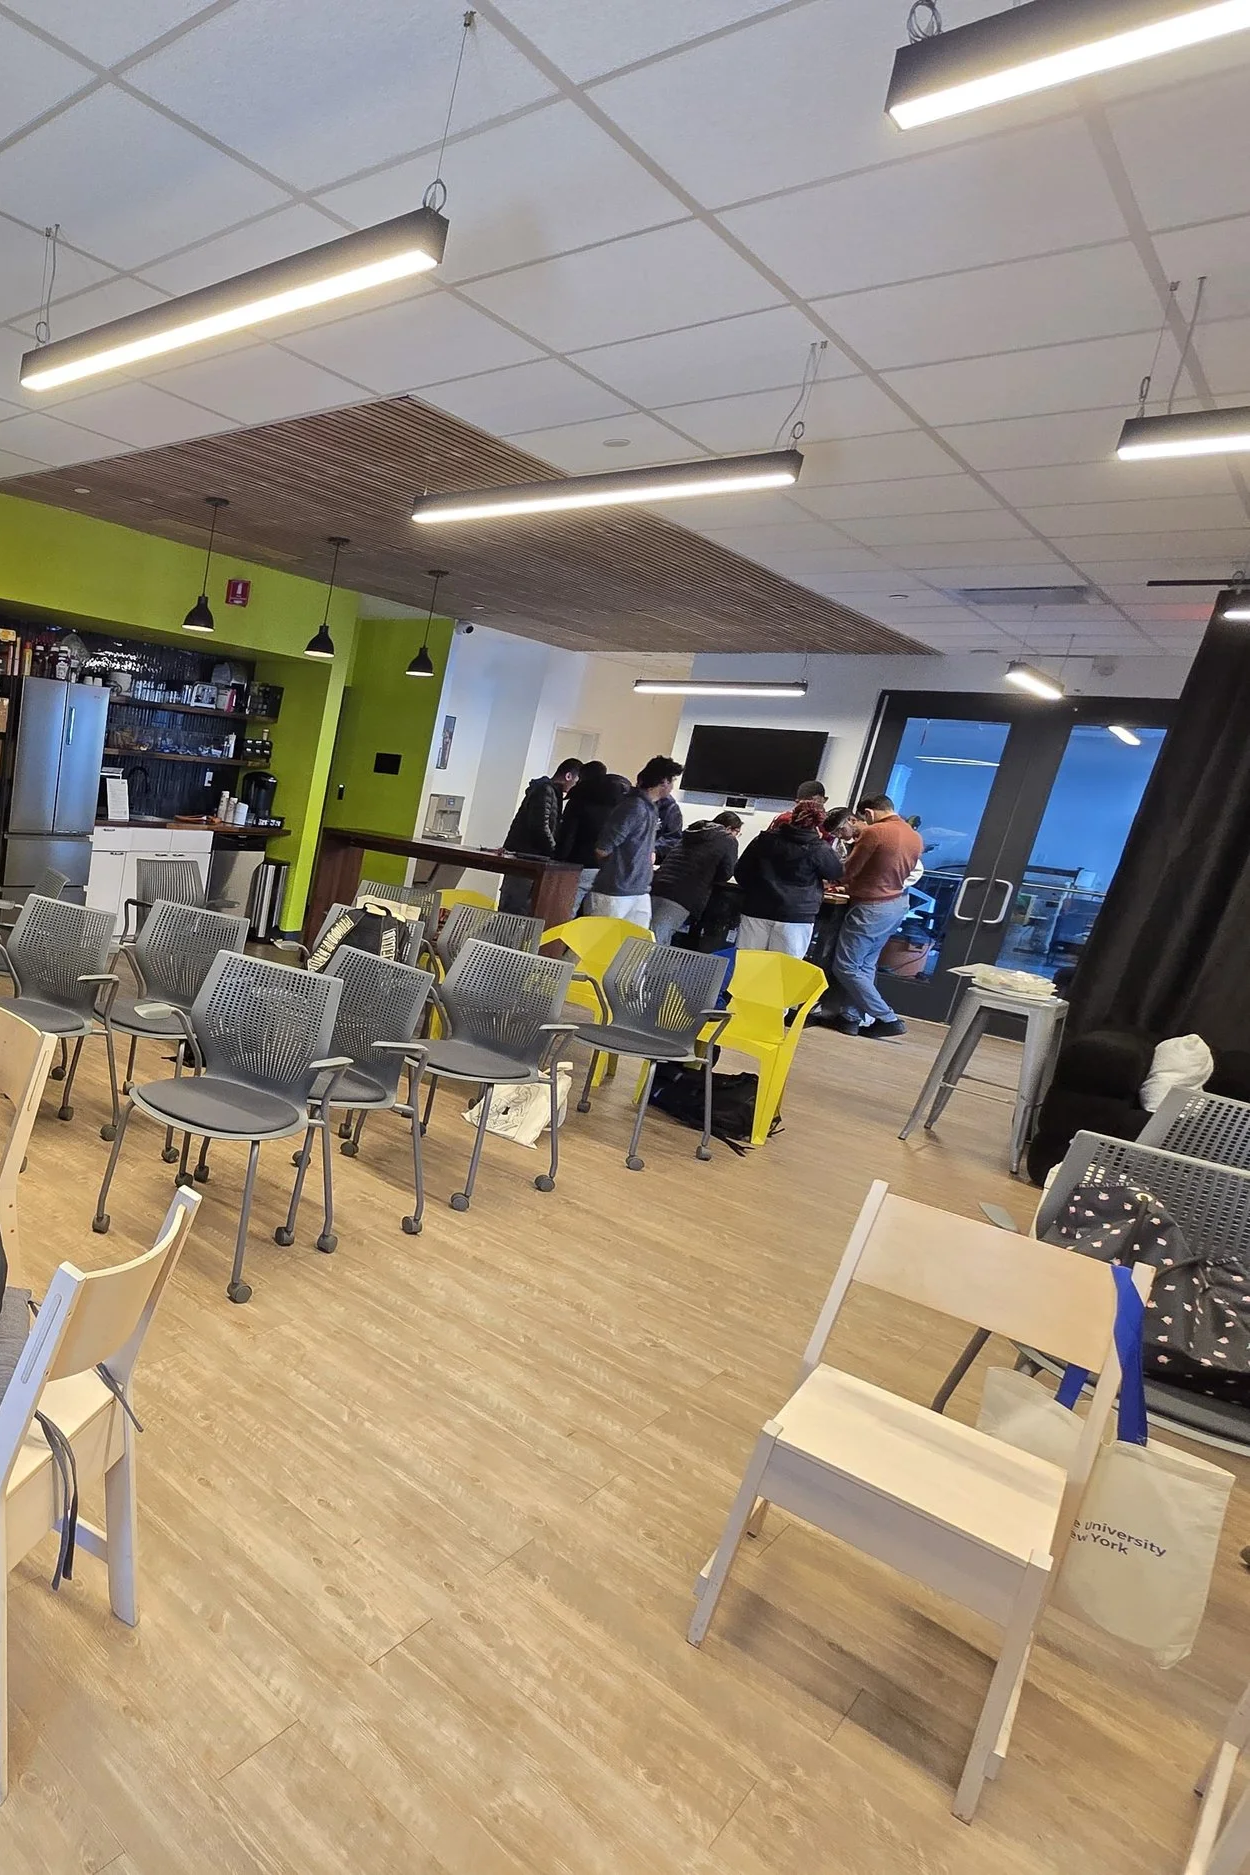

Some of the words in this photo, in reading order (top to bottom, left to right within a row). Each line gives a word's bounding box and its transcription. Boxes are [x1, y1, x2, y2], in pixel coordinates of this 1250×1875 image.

[1069, 1529, 1088, 1542] ew
[1090, 1532, 1129, 1555] York
[1084, 1521, 1167, 1557] University
